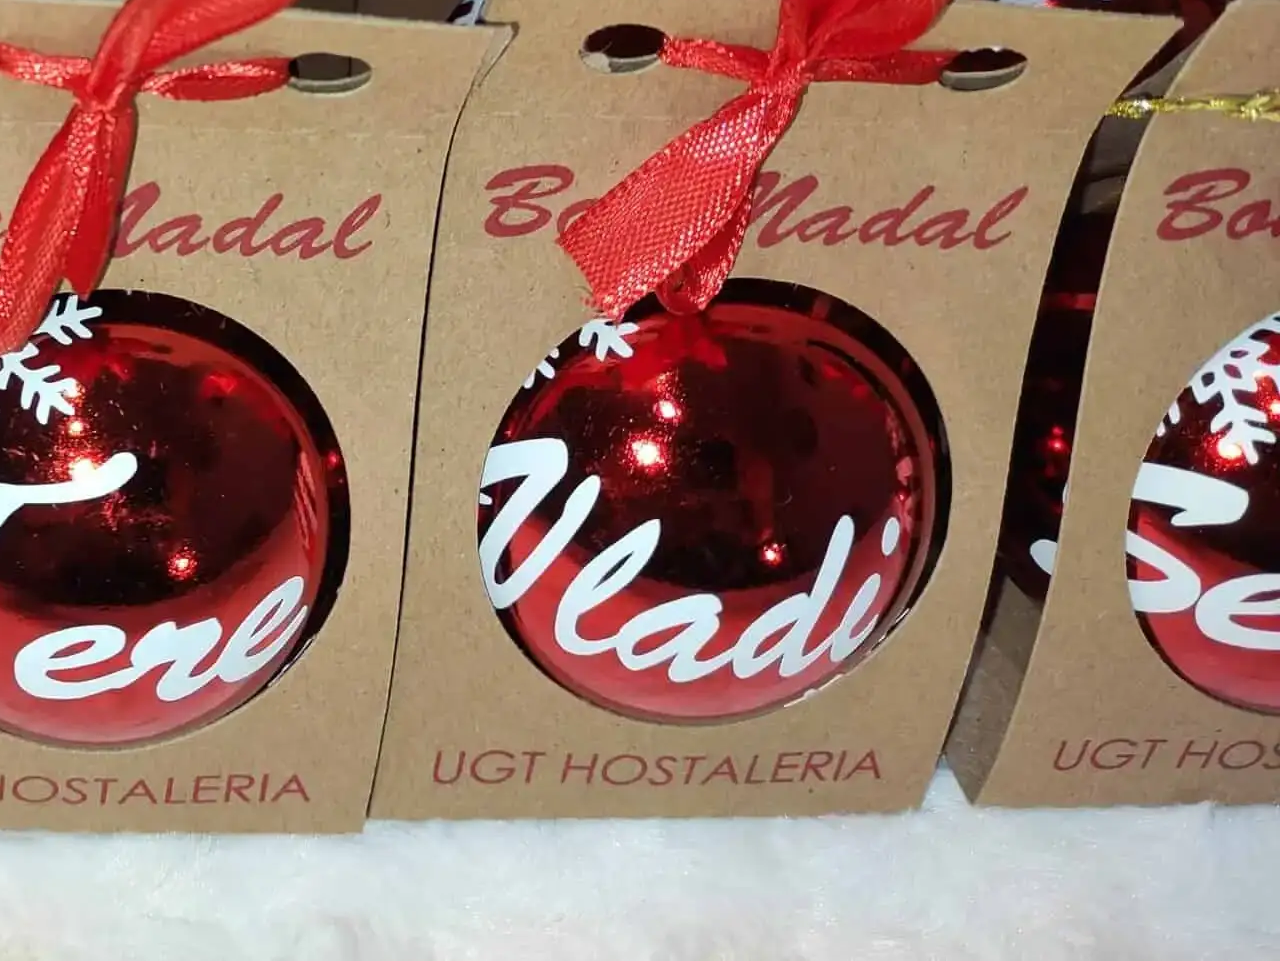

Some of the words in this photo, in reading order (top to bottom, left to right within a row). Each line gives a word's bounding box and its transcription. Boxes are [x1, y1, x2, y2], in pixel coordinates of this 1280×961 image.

[1156, 167, 1280, 242] Bo
[477, 437, 901, 684] Vladi
[432, 749, 545, 786] UGT
[561, 749, 882, 787] HOSTALERIA
[1052, 737, 1168, 772] UGT
